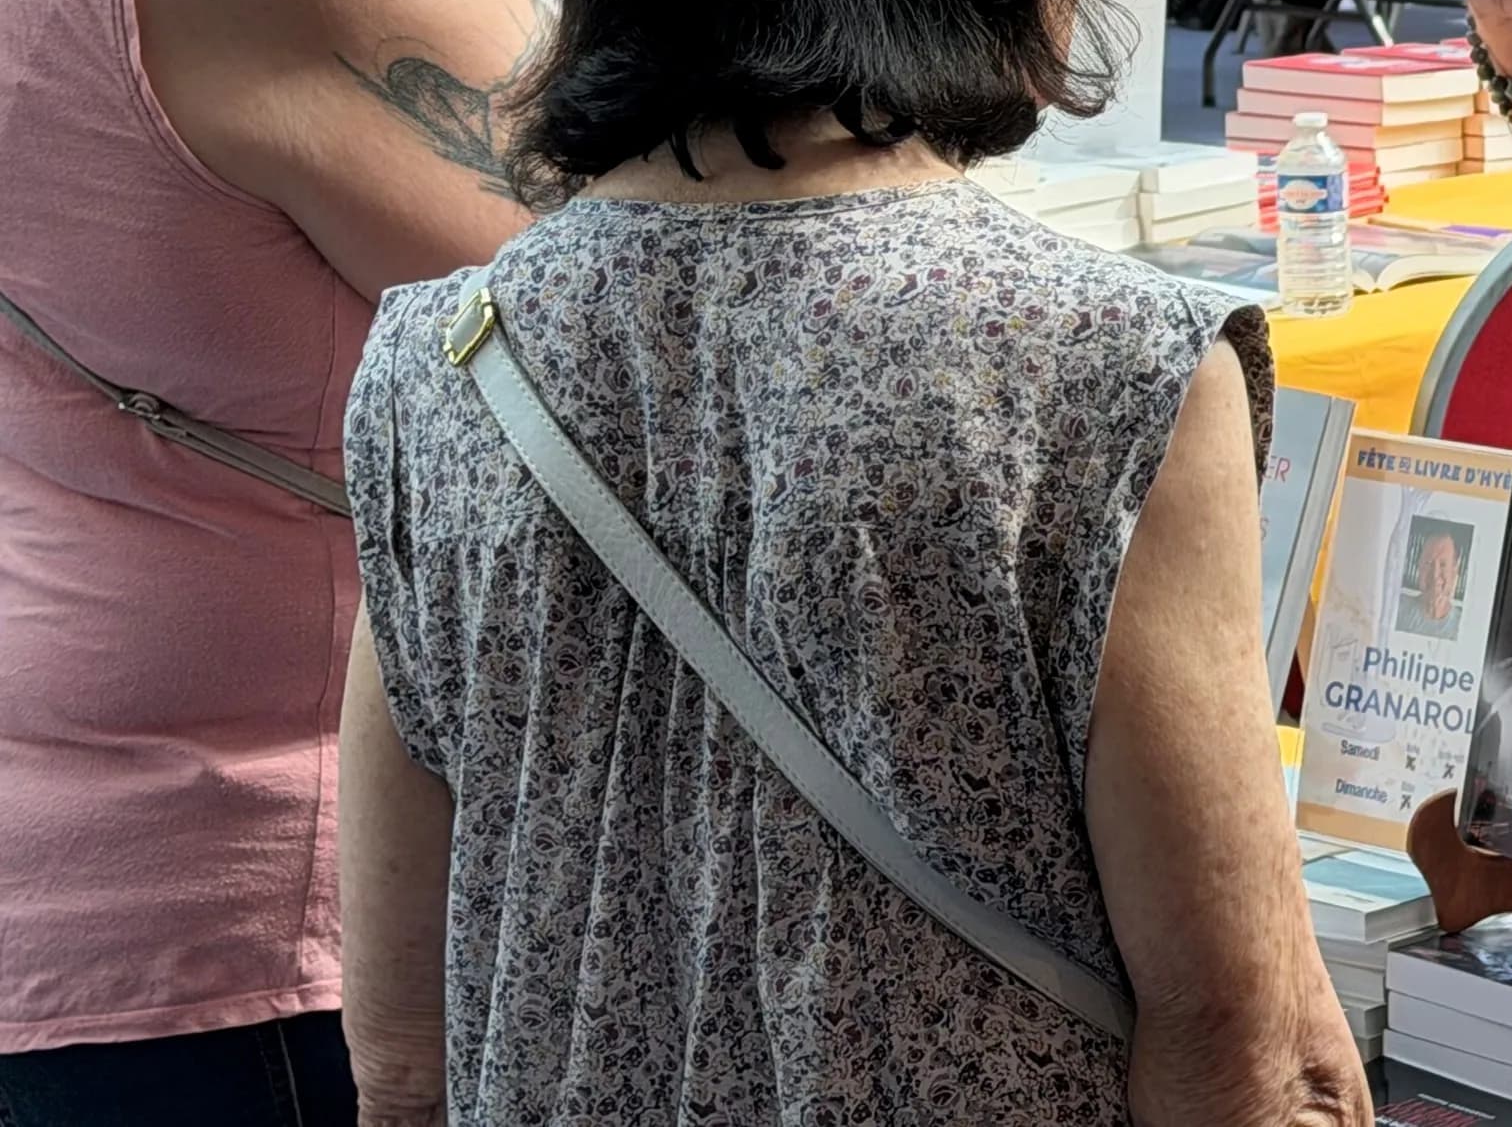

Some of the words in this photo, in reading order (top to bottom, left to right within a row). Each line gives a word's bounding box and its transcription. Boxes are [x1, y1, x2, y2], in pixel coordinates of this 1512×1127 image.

[1357, 447, 1396, 471] FÊTE
[1414, 459, 1461, 481] LIVRE
[1363, 646, 1475, 695] Philippe
[1340, 739, 1380, 761] Samedi
[1335, 778, 1388, 804] Dimanche
